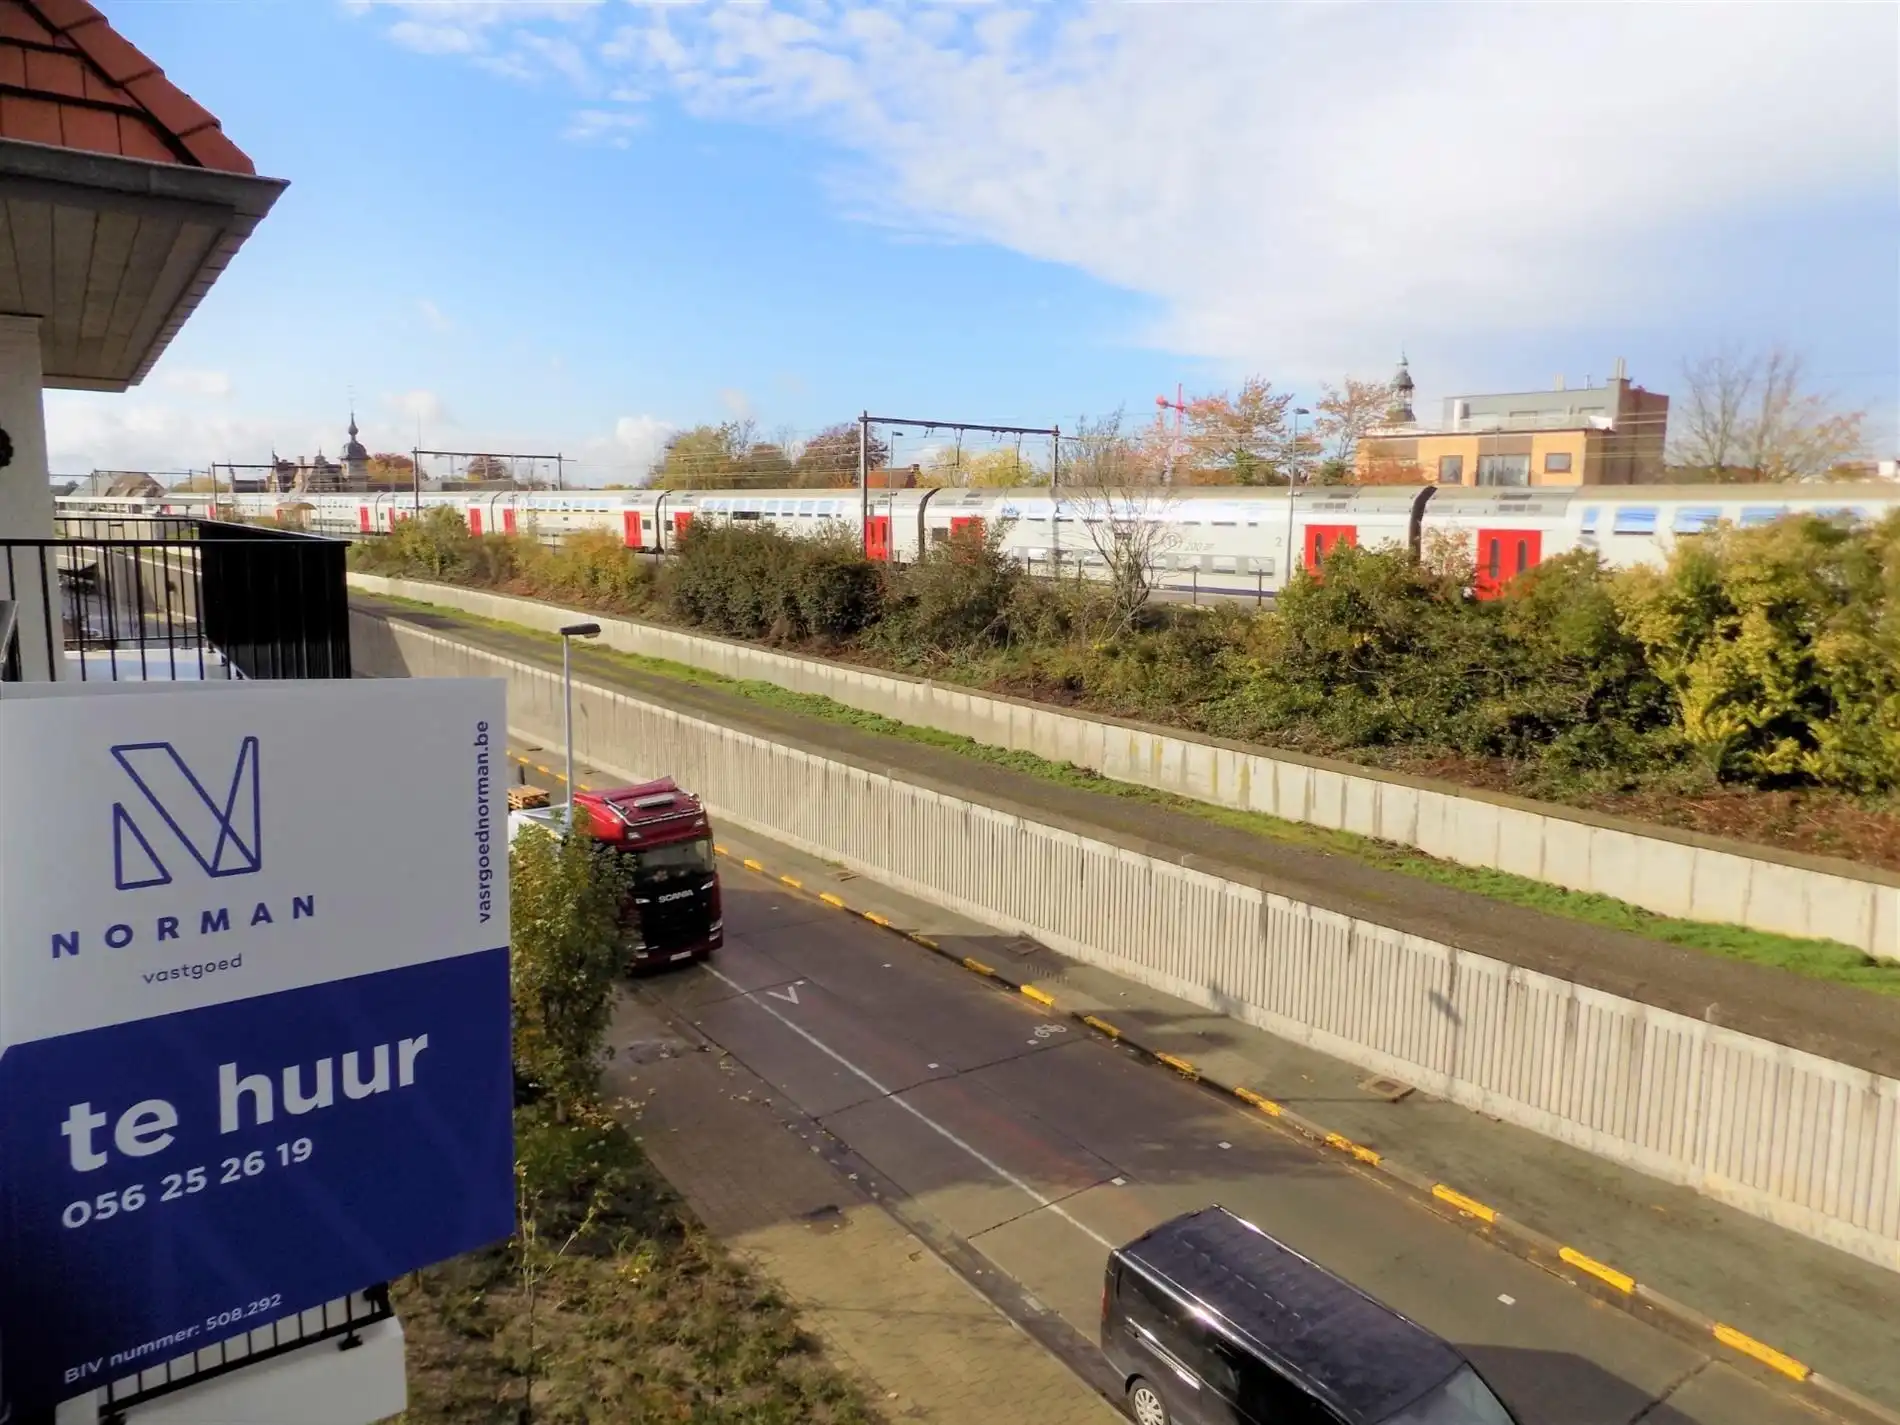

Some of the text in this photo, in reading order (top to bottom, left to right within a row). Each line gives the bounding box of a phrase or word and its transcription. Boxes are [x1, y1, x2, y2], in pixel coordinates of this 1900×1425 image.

[473, 720, 494, 924] vasrgoednorman.be
[51, 894, 315, 960] NORMAN
[658, 888, 694, 904] SCANIA
[142, 952, 243, 985] vastgoed
[61, 1033, 429, 1173] te huur
[61, 1137, 314, 1229] 056 25 26 19
[63, 1292, 283, 1385] BIV nummer: 508.292
